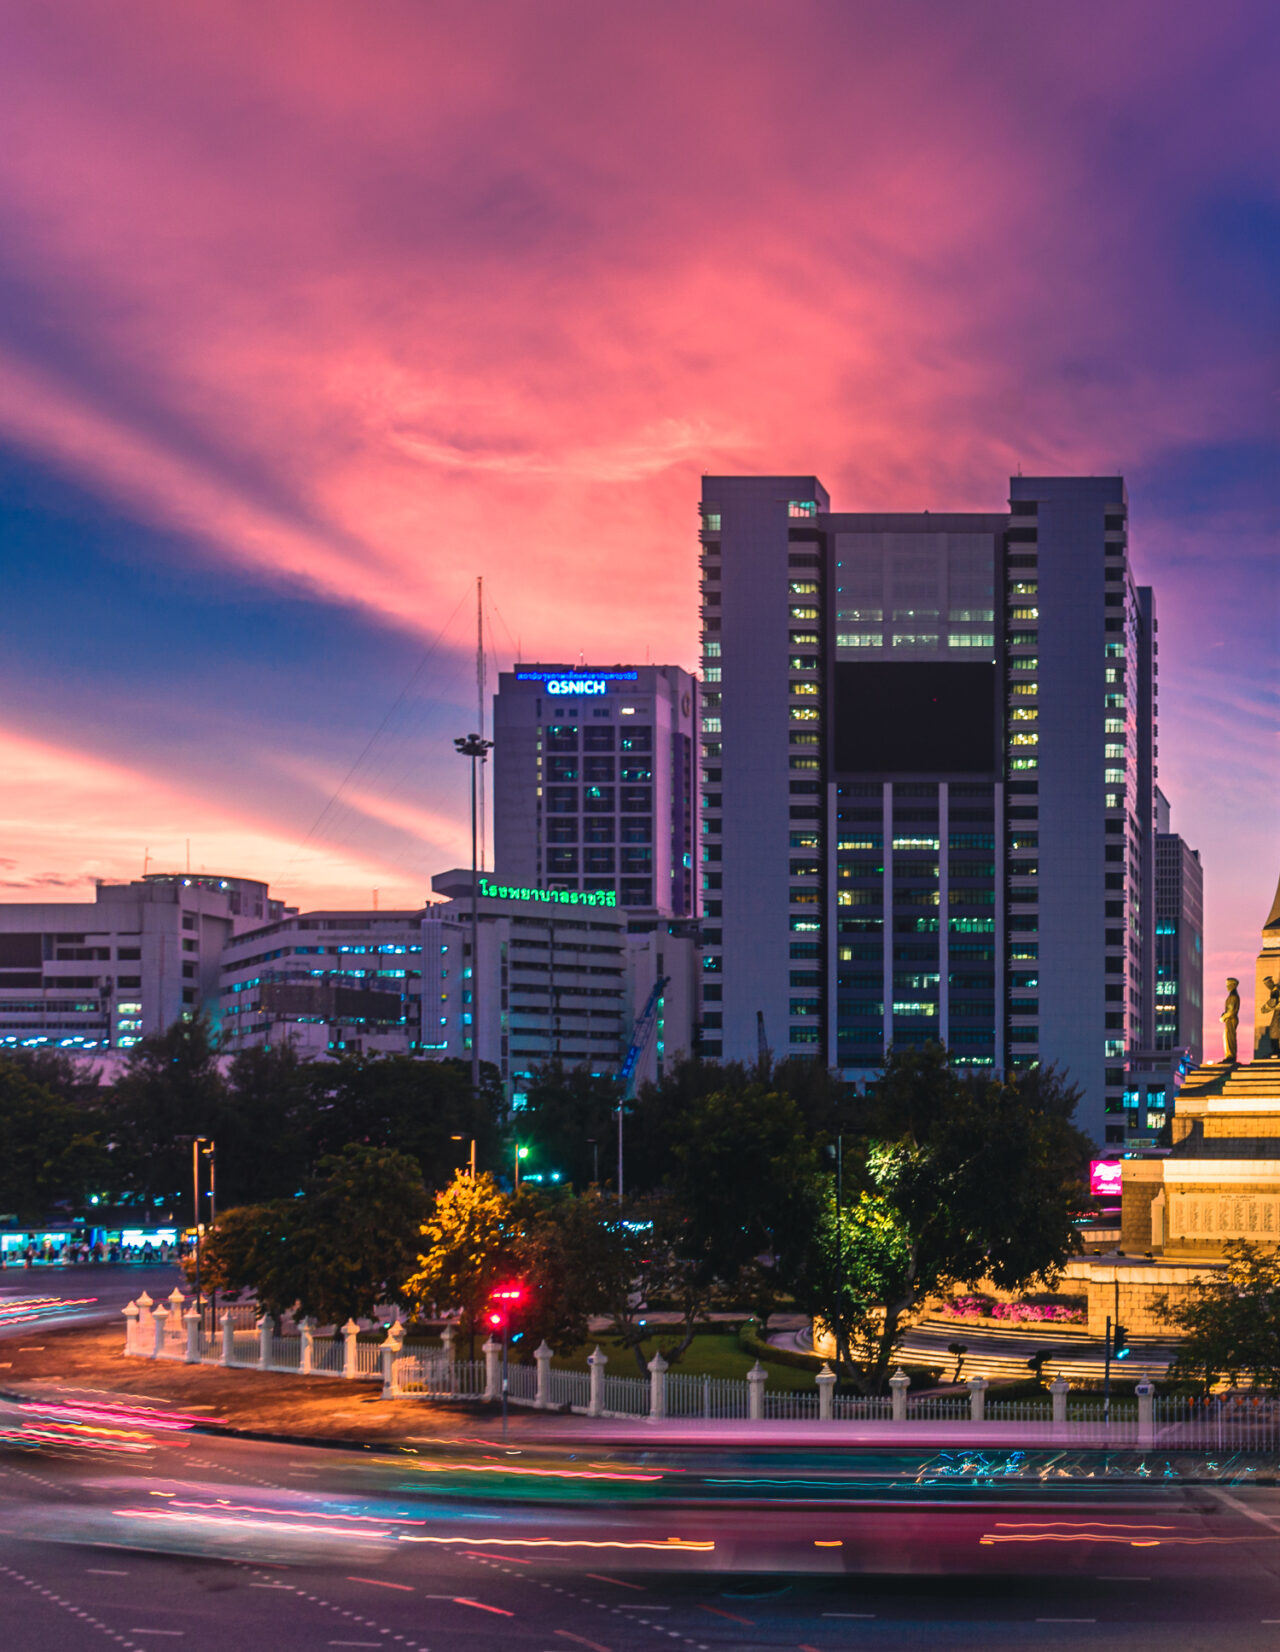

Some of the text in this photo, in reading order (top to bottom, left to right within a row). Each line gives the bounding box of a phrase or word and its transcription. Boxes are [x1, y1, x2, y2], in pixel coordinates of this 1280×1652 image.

[547, 680, 606, 694] QSNICH
[478, 878, 617, 908] โรงพยาบาลราชวิถี
